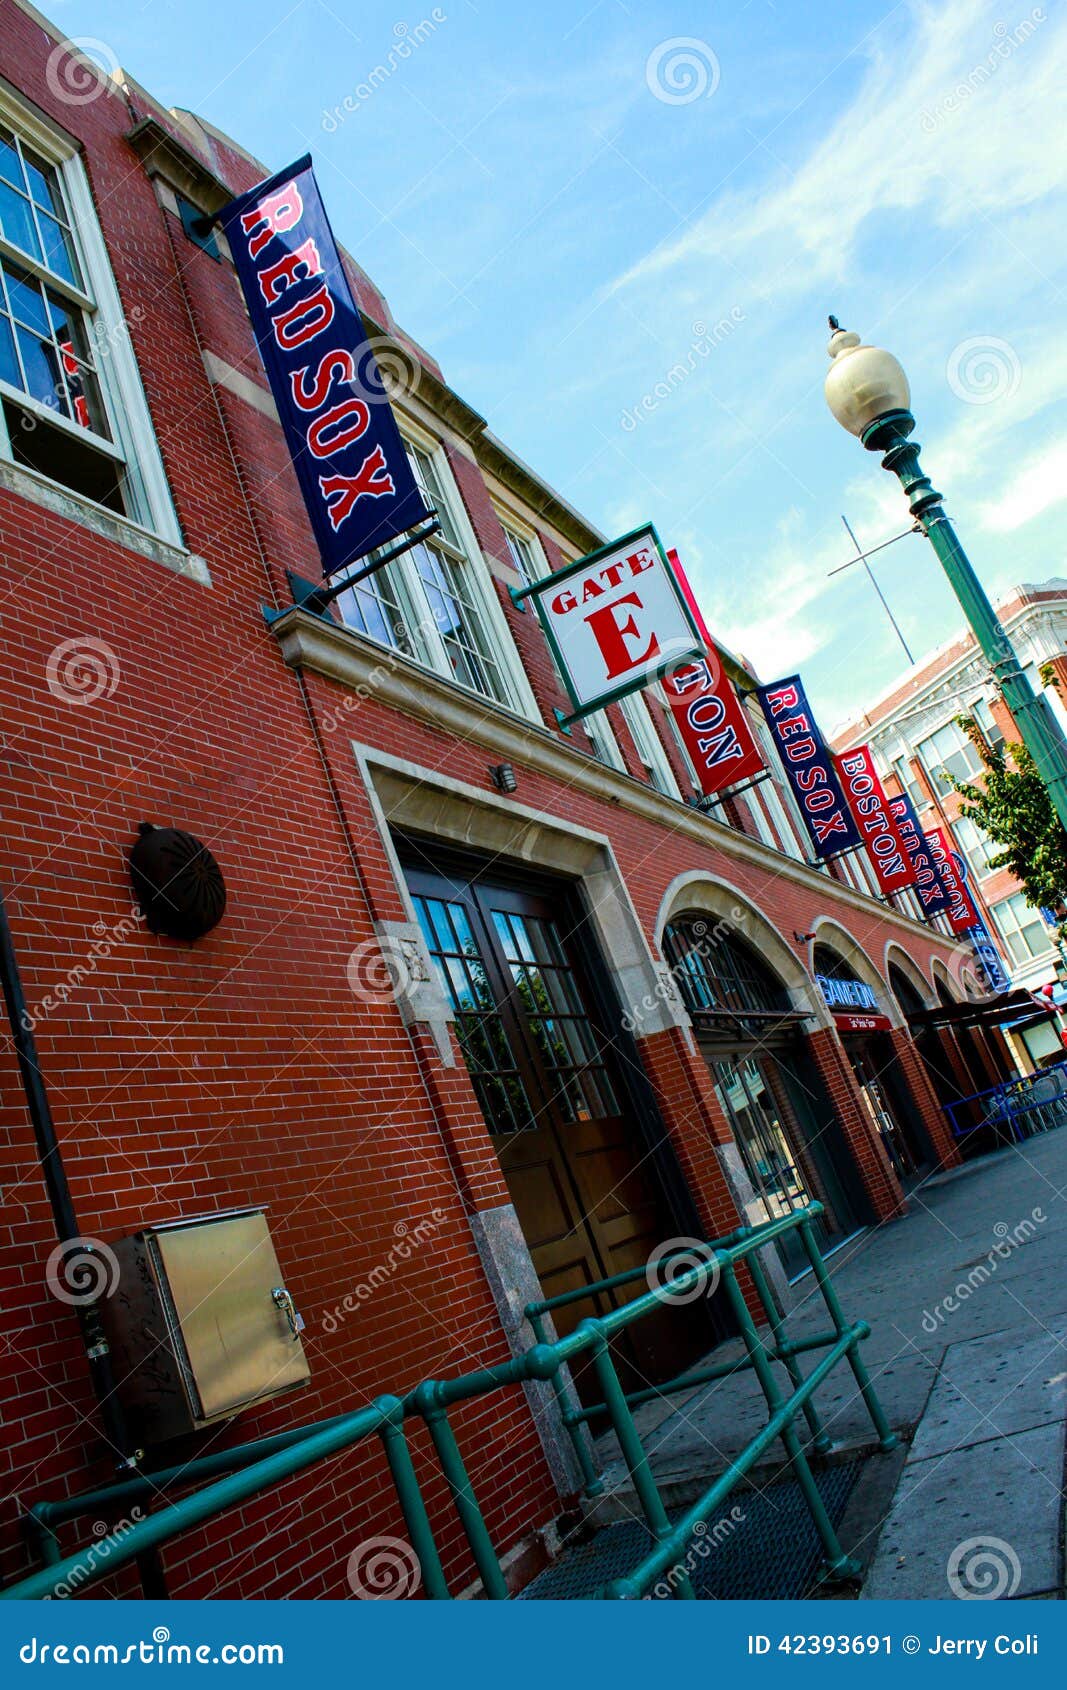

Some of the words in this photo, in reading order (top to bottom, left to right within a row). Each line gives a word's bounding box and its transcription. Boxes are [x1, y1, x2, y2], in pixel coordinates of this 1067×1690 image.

[241, 181, 335, 351] RED
[289, 349, 395, 533] SOX
[551, 548, 654, 615] GATE
[584, 591, 662, 680] E
[766, 684, 816, 762] RED
[795, 766, 848, 844] SOX
[841, 752, 907, 878] BOSTON
[889, 800, 920, 855] RED
[910, 854, 943, 906] SOX
[925, 832, 970, 921] BOSTON
